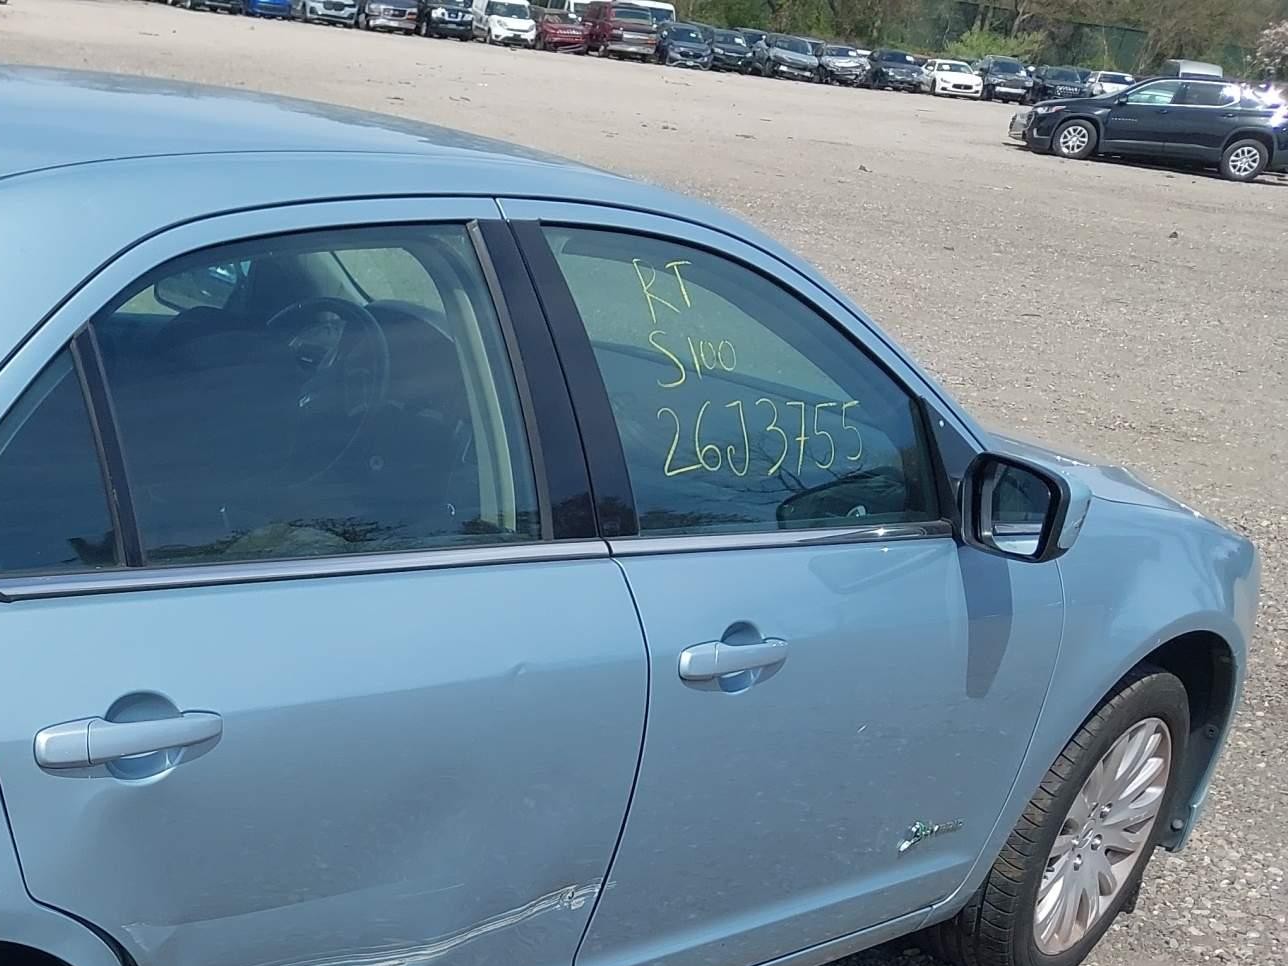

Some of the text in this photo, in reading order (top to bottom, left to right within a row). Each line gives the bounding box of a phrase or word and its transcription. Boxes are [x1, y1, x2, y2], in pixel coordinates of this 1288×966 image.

[632, 258, 692, 323] RT
[648, 331, 737, 388] S100
[657, 398, 863, 477] 26J3755
